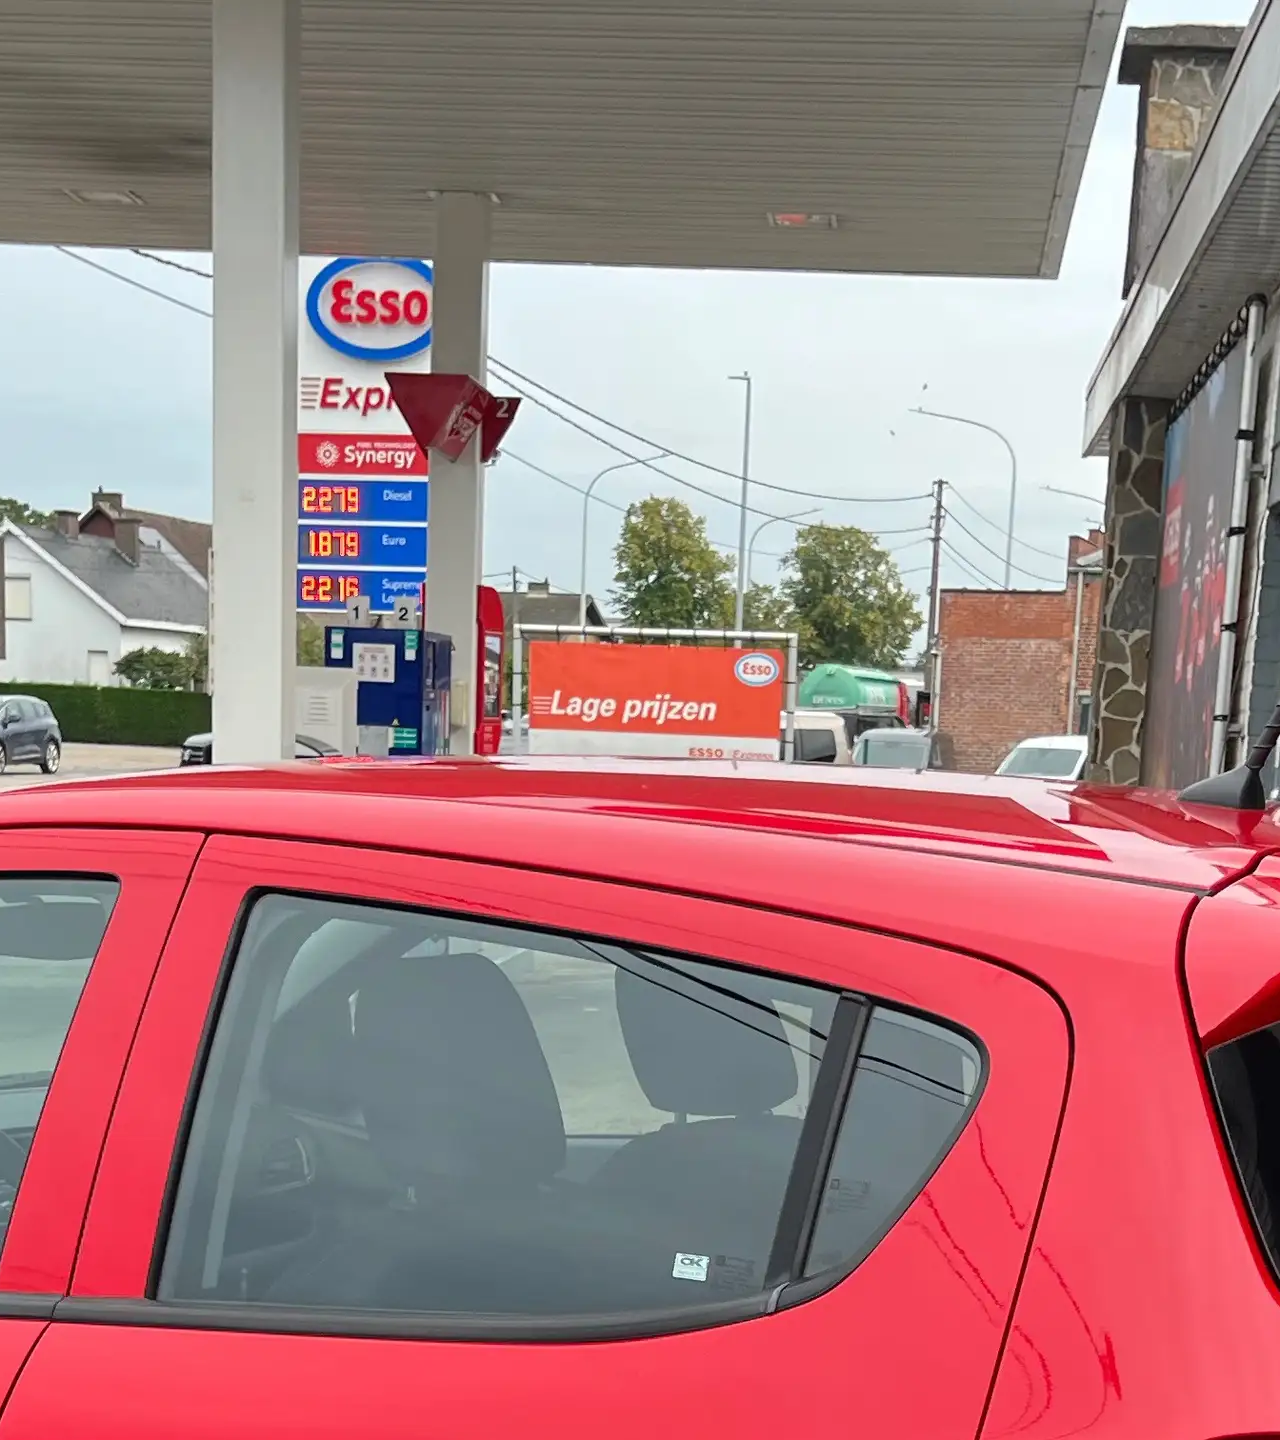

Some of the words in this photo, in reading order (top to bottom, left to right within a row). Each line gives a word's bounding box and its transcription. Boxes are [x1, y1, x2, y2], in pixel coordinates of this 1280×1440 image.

[330, 279, 428, 325] Esso
[496, 398, 510, 418] 2
[344, 446, 416, 469] Synergy
[383, 489, 412, 502] Diesel
[382, 534, 407, 546] Euro
[352, 606, 360, 620] 1
[398, 607, 409, 621] 2
[742, 662, 772, 676] Esso
[550, 690, 617, 722] Lage
[622, 694, 718, 725] prijzen
[688, 747, 724, 759] ESSO
